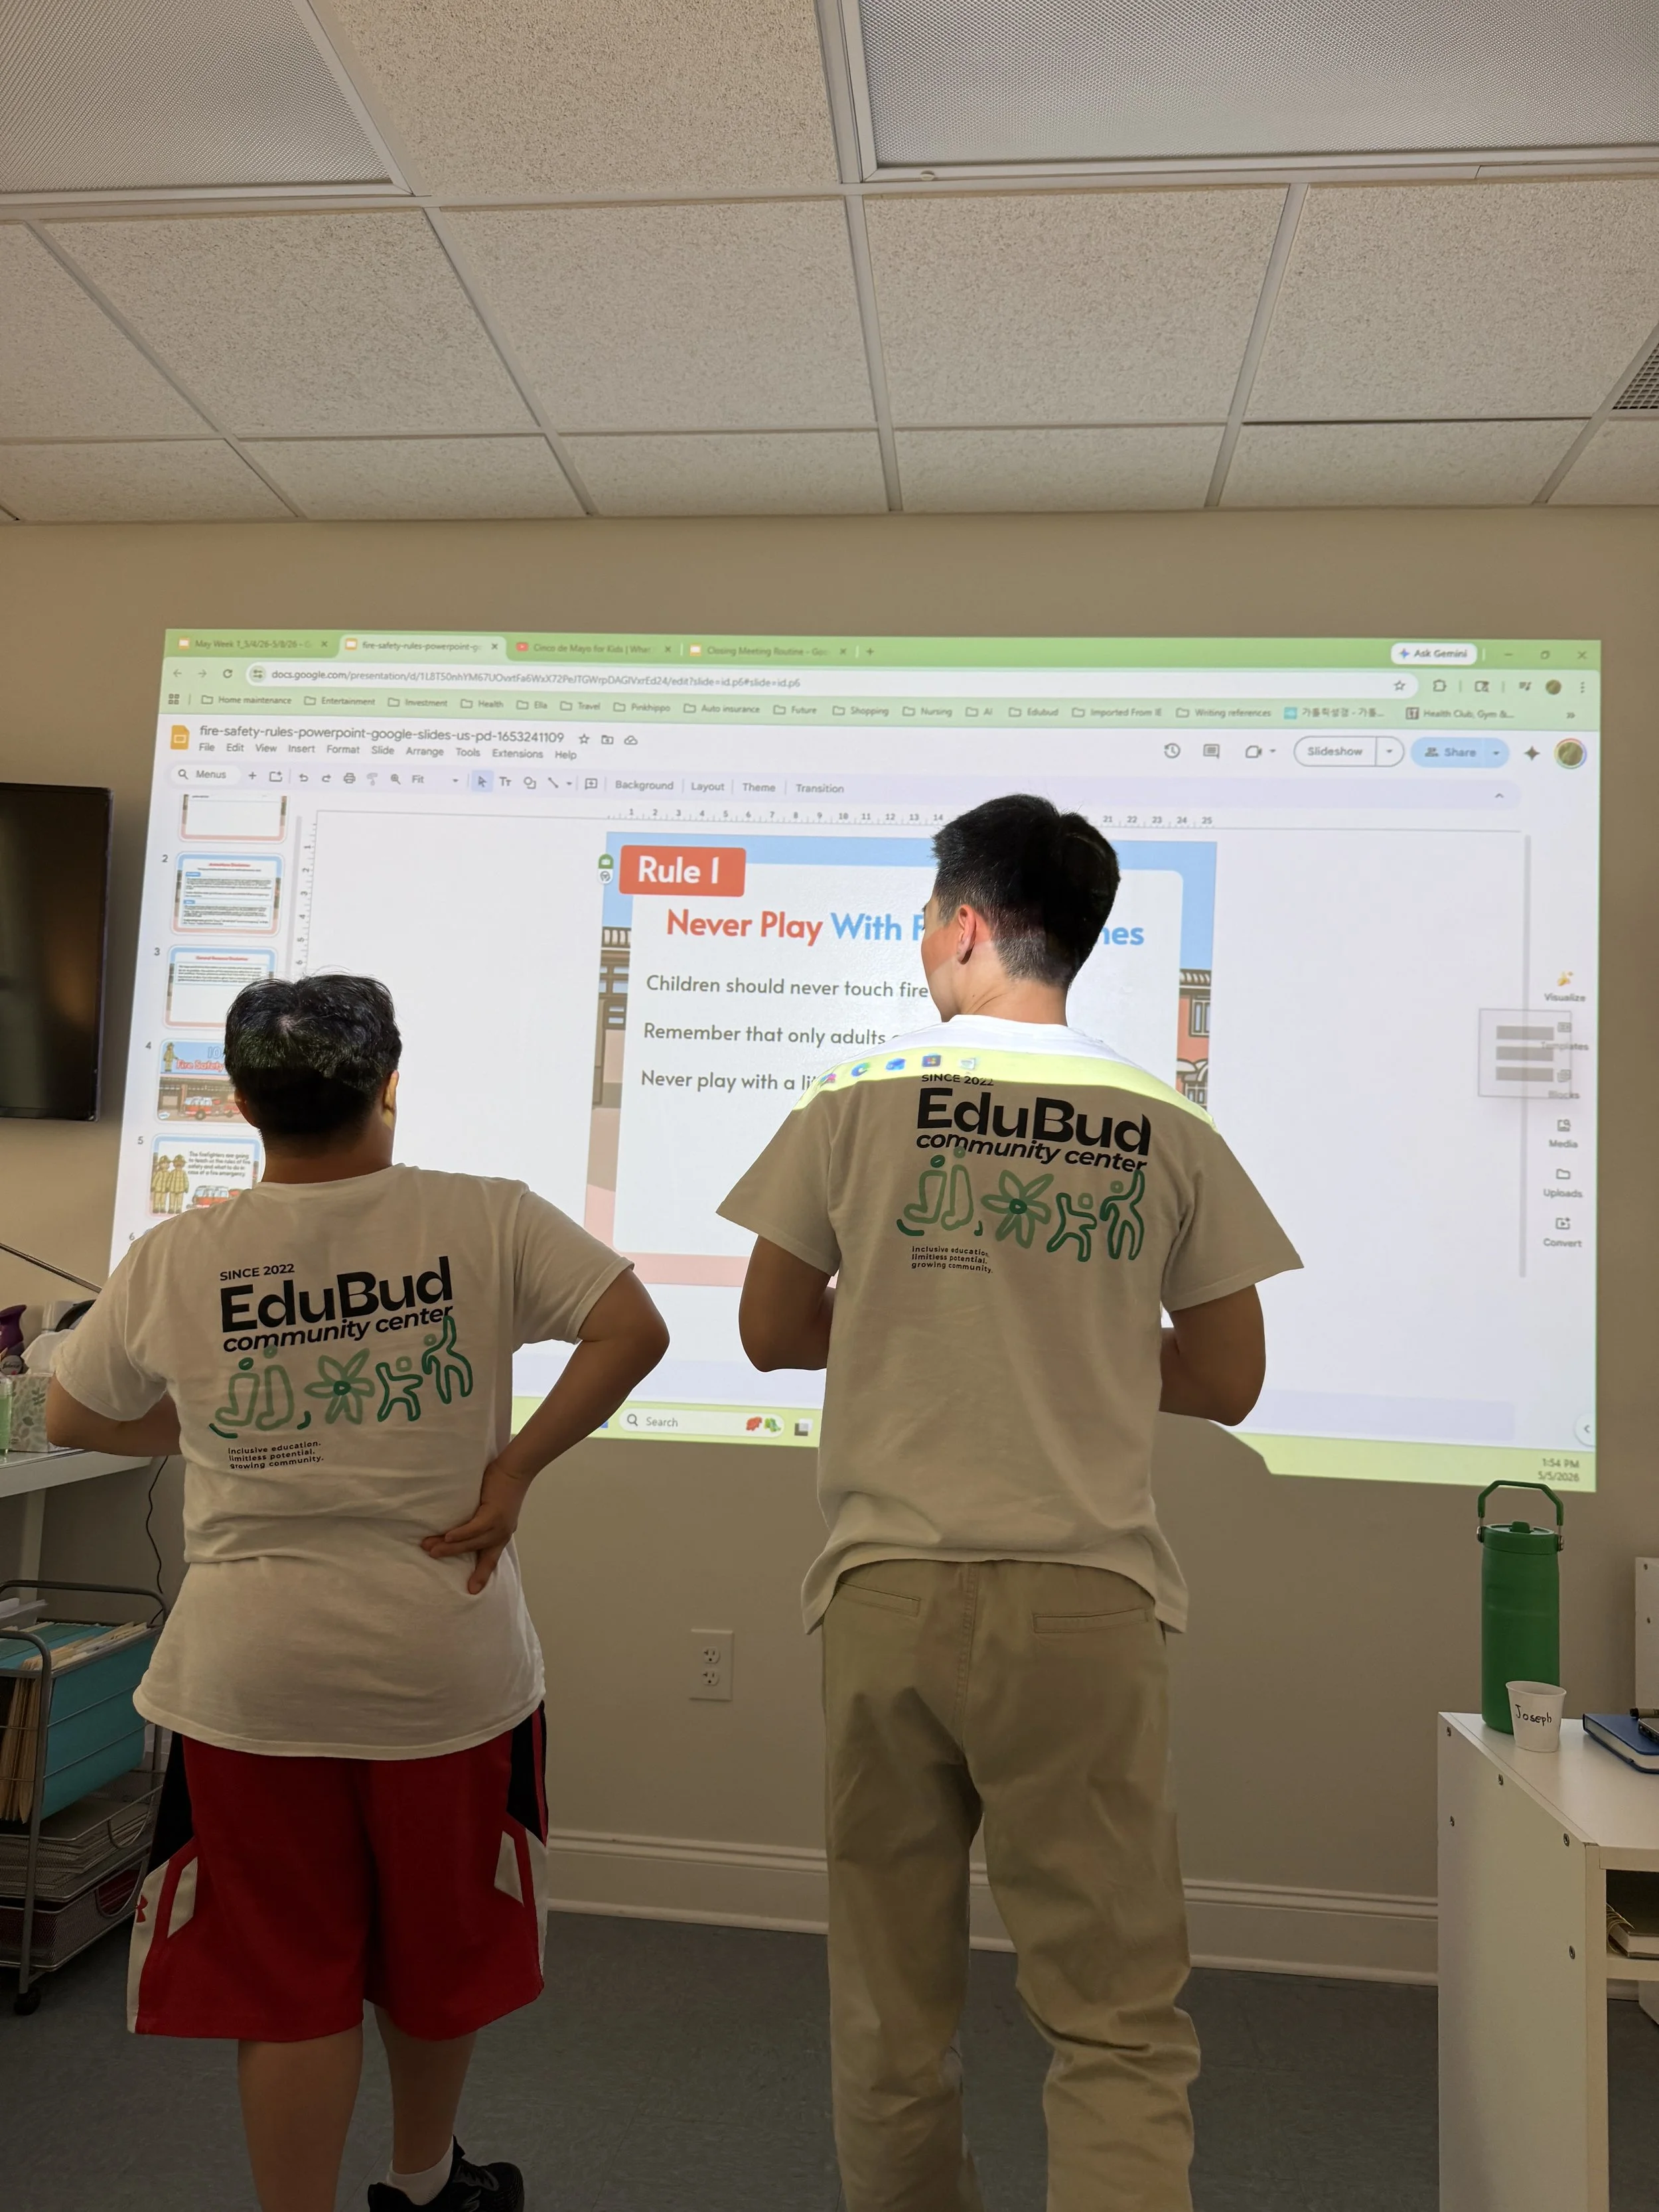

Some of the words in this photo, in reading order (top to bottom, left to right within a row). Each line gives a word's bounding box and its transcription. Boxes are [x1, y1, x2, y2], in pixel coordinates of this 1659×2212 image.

[195, 640, 211, 649] May
[214, 640, 233, 648] Week
[534, 644, 555, 652] Cinco
[569, 645, 591, 654] Mayo
[707, 646, 737, 656] Closing
[739, 646, 772, 657] Meeting
[774, 646, 804, 656] Routine
[1433, 650, 1467, 658] Gemini
[218, 696, 241, 704] Home
[244, 696, 292, 705] maintenance
[321, 697, 375, 705] Entertainment
[405, 699, 448, 707] Investment
[478, 700, 504, 709] Health
[577, 701, 601, 710] Travel
[631, 703, 671, 713] Pinkhippo
[701, 704, 721, 713] Auto
[723, 705, 760, 713] insurance
[791, 705, 817, 714] Future
[850, 707, 889, 717] Shopping
[920, 707, 953, 717] Nursing
[1090, 708, 1129, 718] Imported
[1131, 708, 1152, 717] From
[1195, 709, 1226, 719] Writing
[1228, 709, 1271, 717] references
[1423, 709, 1451, 718] Health
[1453, 710, 1476, 719] Club,
[1477, 710, 1497, 719] Gym
[200, 725, 565, 744] fire-safety-rules-powerpoint-google-slides-us-pd-1653241109
[199, 743, 215, 752] File
[226, 743, 244, 752] Edit
[255, 744, 277, 753] View
[289, 744, 316, 753] Insert
[326, 745, 360, 754] Format
[371, 745, 395, 755] Slide
[405, 747, 444, 758] Arrange
[456, 747, 481, 757] Tools
[1307, 747, 1363, 757] Slideshow
[1444, 747, 1477, 757] Share
[492, 749, 543, 759] Extensions
[555, 750, 577, 761] Help
[196, 770, 226, 779] Menus
[412, 774, 425, 784] Fit
[615, 779, 674, 792] Background
[691, 781, 725, 792] Layout
[742, 782, 776, 792] Theme
[796, 783, 845, 794] Transition
[162, 854, 169, 863] 2
[638, 855, 701, 884] Rule
[667, 909, 753, 937] Never
[760, 911, 824, 946] Play
[830, 912, 902, 940] With
[154, 947, 161, 956] 3
[646, 974, 721, 994] Children
[726, 976, 785, 994] should
[790, 982, 840, 996] never
[844, 981, 893, 997] touch
[899, 981, 928, 998] fire
[1544, 993, 1587, 1002] Visualize
[644, 1022, 741, 1041] Remember
[746, 1026, 784, 1043] that
[788, 1027, 826, 1049] only
[830, 1029, 886, 1045] adults
[145, 1041, 152, 1050] 4
[193, 1059, 224, 1072] Safety
[641, 1070, 693, 1088] Never
[697, 1070, 737, 1093] play
[741, 1073, 778, 1090] with
[784, 1078, 795, 1090] a
[921, 1073, 961, 1084] SINCE
[916, 1087, 1152, 1156] EduBud
[137, 1136, 144, 1145] 5
[1549, 1139, 1579, 1149] Media
[916, 1132, 1062, 1165] community
[1064, 1149, 1147, 1173] center
[1543, 1188, 1583, 1199] Uploads
[129, 1232, 135, 1241] 6
[1543, 1238, 1583, 1248] Convert
[912, 1245, 950, 1254] inclusive
[911, 1253, 948, 1262] limitless
[949, 1254, 987, 1265] potential.
[220, 1266, 260, 1282] SINCE
[263, 1263, 295, 1276] 2022
[911, 1262, 947, 1270] growing
[948, 1263, 993, 1274] community.
[220, 1256, 453, 1333] EduBud
[223, 1319, 371, 1353] community
[375, 1305, 454, 1333] center
[646, 1416, 678, 1428] Search
[228, 1446, 269, 1456] inclusive
[271, 1439, 322, 1453] education.
[229, 1453, 267, 1463] limitless
[269, 1448, 316, 1461] potential.
[230, 1460, 266, 1470] growing
[269, 1456, 325, 1468] community.
[1542, 1458, 1561, 1467] 1:54
[1563, 1459, 1579, 1468] PM
[1538, 1470, 1580, 1482] 5/5/2026
[1514, 1704, 1552, 1727] Joseph
